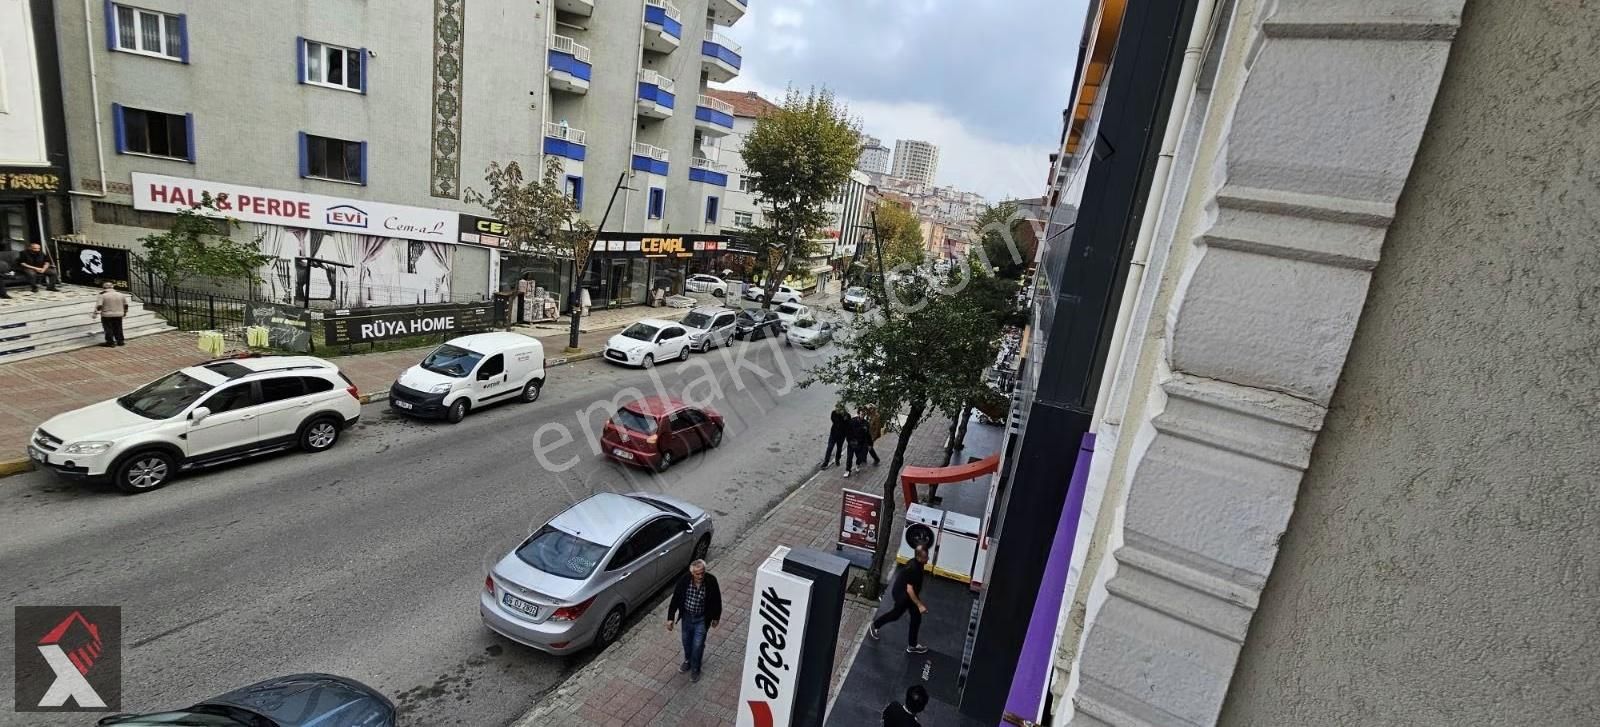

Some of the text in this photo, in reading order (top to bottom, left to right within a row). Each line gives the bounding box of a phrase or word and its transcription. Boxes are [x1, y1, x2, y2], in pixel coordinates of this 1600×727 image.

[150, 183, 212, 211] HAL
[215, 192, 232, 211] &
[237, 194, 311, 220] PERDE
[641, 236, 687, 254] CEMAL
[361, 319, 408, 339] RÜYA
[410, 316, 455, 333] HOME
[754, 586, 792, 700] arçelik
